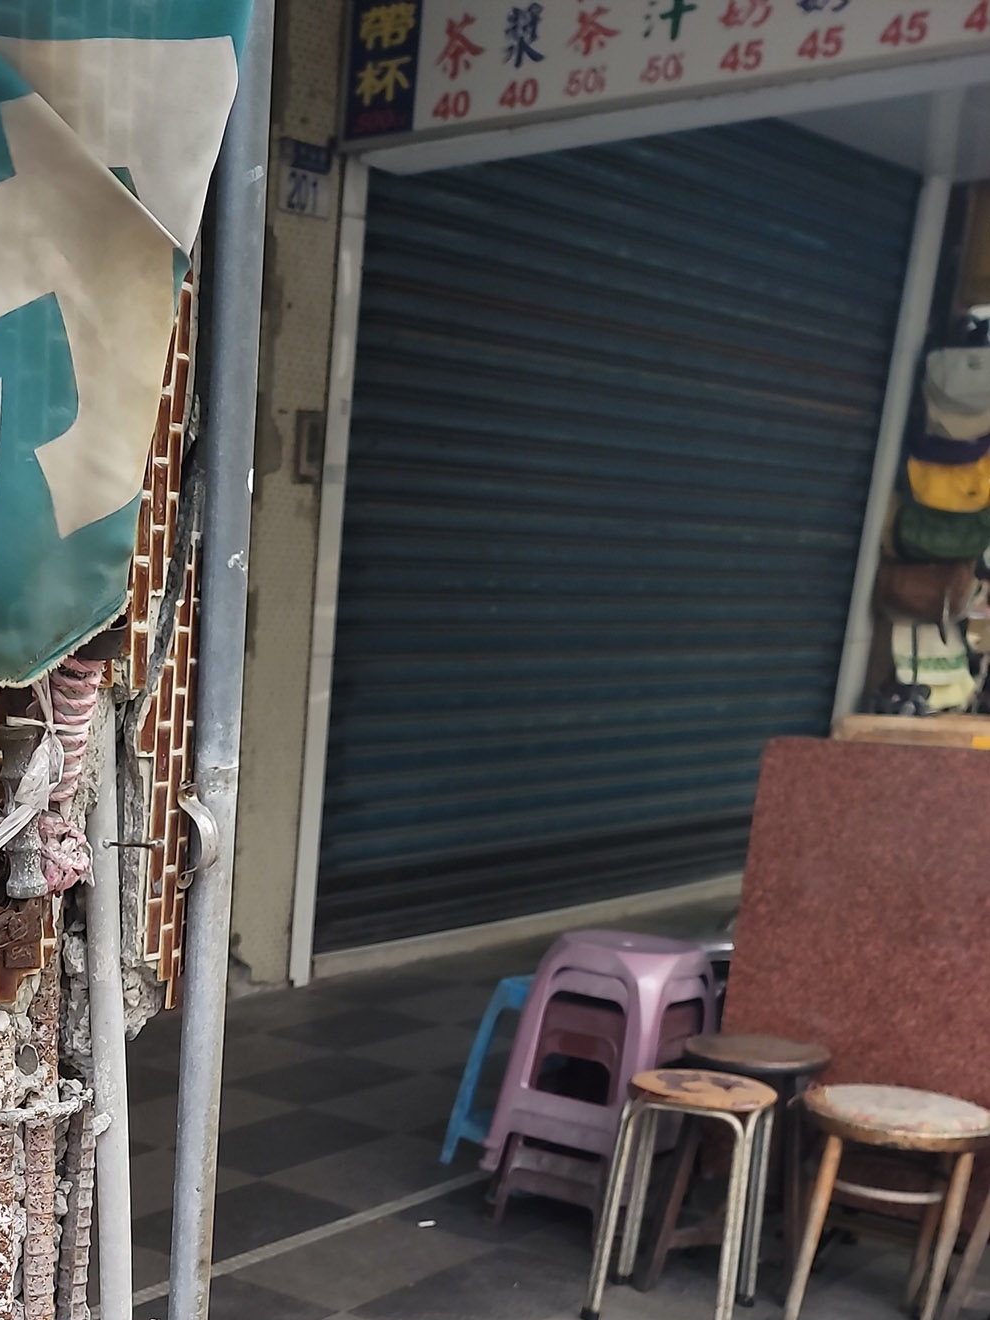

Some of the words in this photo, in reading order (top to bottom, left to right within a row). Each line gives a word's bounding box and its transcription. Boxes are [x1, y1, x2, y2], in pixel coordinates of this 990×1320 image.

[567, 6, 619, 57] 茶
[880, 11, 930, 46] 45
[964, 0, 990, 31] 4
[436, 12, 485, 80] 茶
[720, 40, 764, 71] 45
[798, 26, 845, 60] 45
[432, 90, 470, 120] 40
[499, 78, 538, 108] 40
